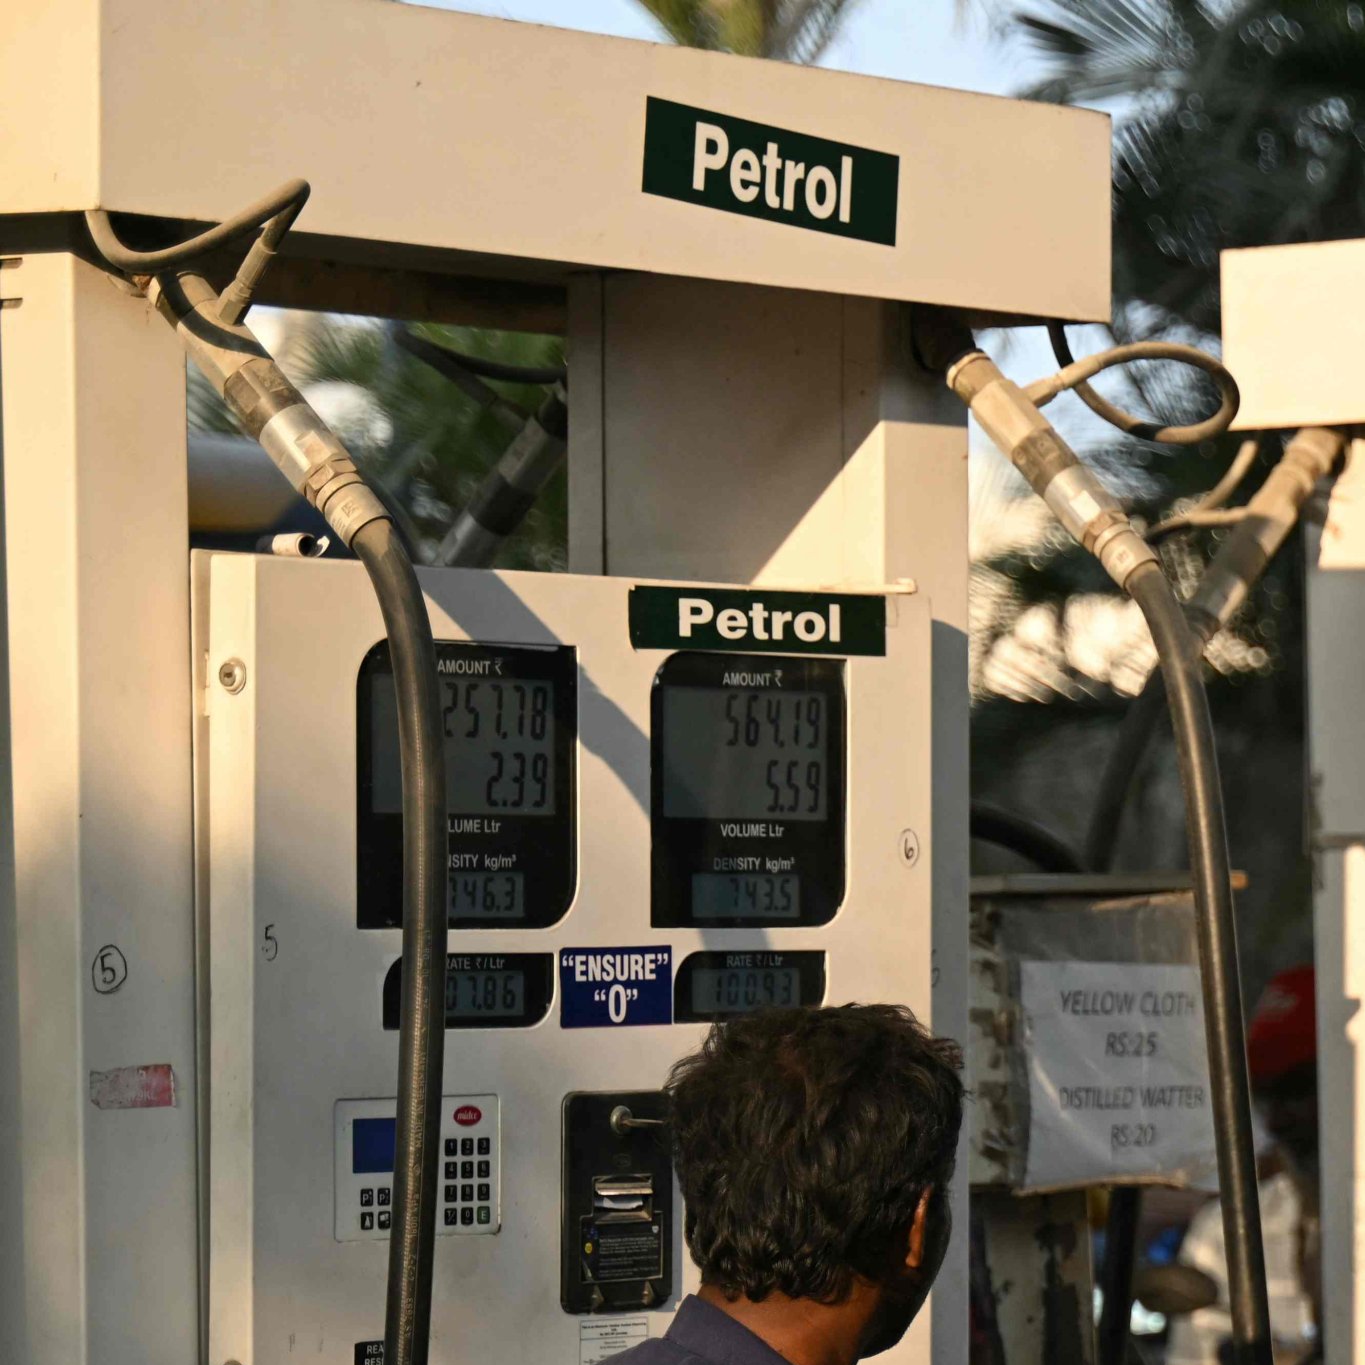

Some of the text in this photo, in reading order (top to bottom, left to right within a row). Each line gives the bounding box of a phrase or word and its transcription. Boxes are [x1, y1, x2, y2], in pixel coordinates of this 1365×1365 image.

[692, 120, 853, 224] Petrol
[678, 597, 841, 642] Petrol
[437, 659, 491, 675] AMOUNT
[723, 672, 772, 687] AMOUNT
[443, 682, 548, 740] 257.78
[486, 751, 548, 809] 2.39
[766, 760, 821, 814] 5.59
[447, 819, 501, 834] LUME Ltr
[720, 823, 785, 838] VOLUME Ltr
[448, 853, 479, 868] SITY
[713, 856, 761, 871] DENSITY
[260, 923, 278, 963] 5
[99, 952, 117, 986] 5
[726, 954, 752, 969] RATE
[1060, 990, 1196, 1018] YELLOW CLOTH
[1059, 1084, 1205, 1110] DISTILLED WATTER
